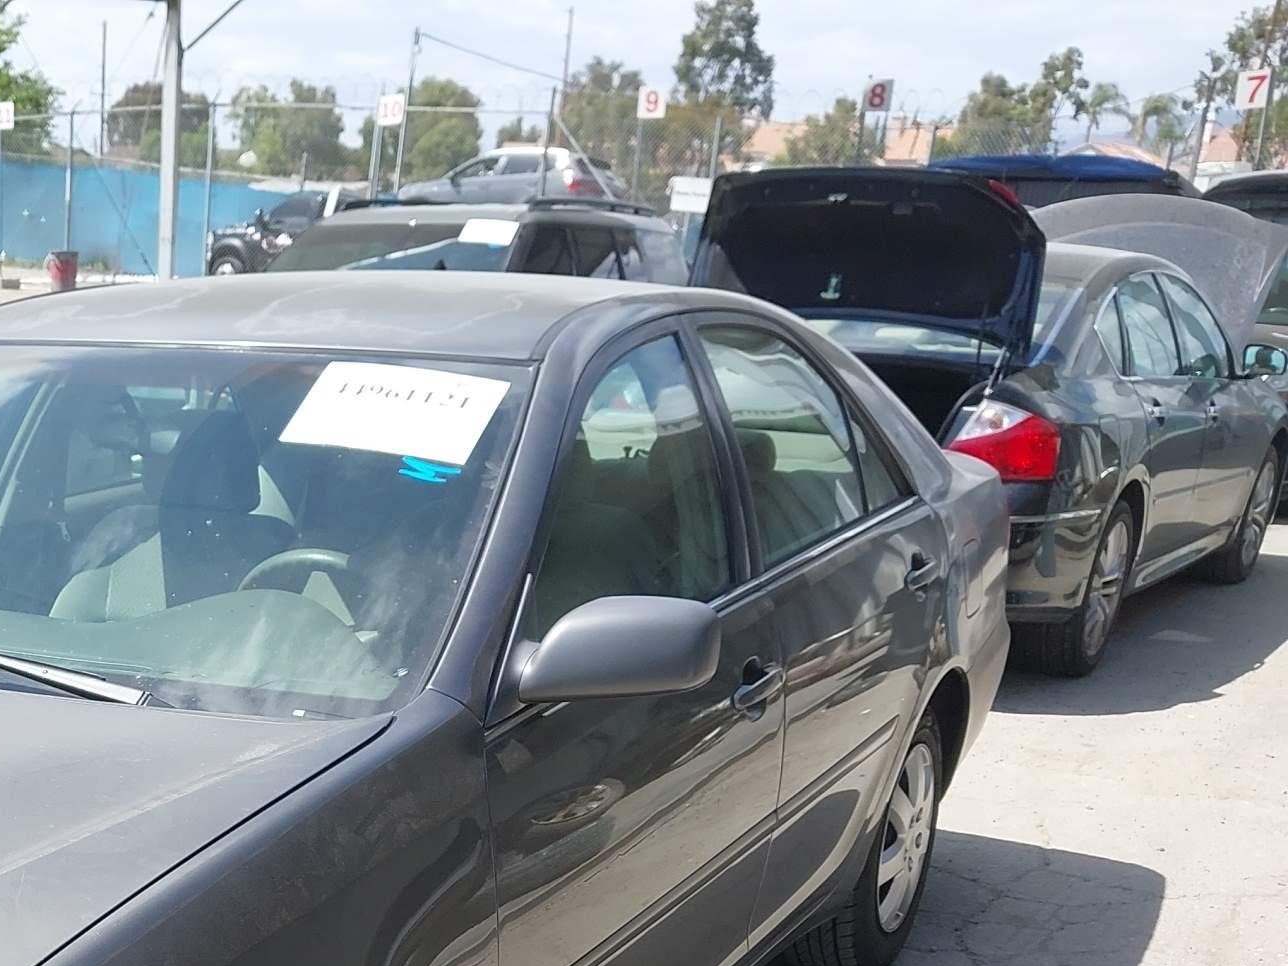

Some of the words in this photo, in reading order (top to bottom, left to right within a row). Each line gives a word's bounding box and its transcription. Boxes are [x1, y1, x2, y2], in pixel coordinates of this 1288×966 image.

[868, 82, 886, 108] 8
[1247, 74, 1268, 103] 7
[383, 101, 402, 118] 10
[646, 90, 659, 113] 9
